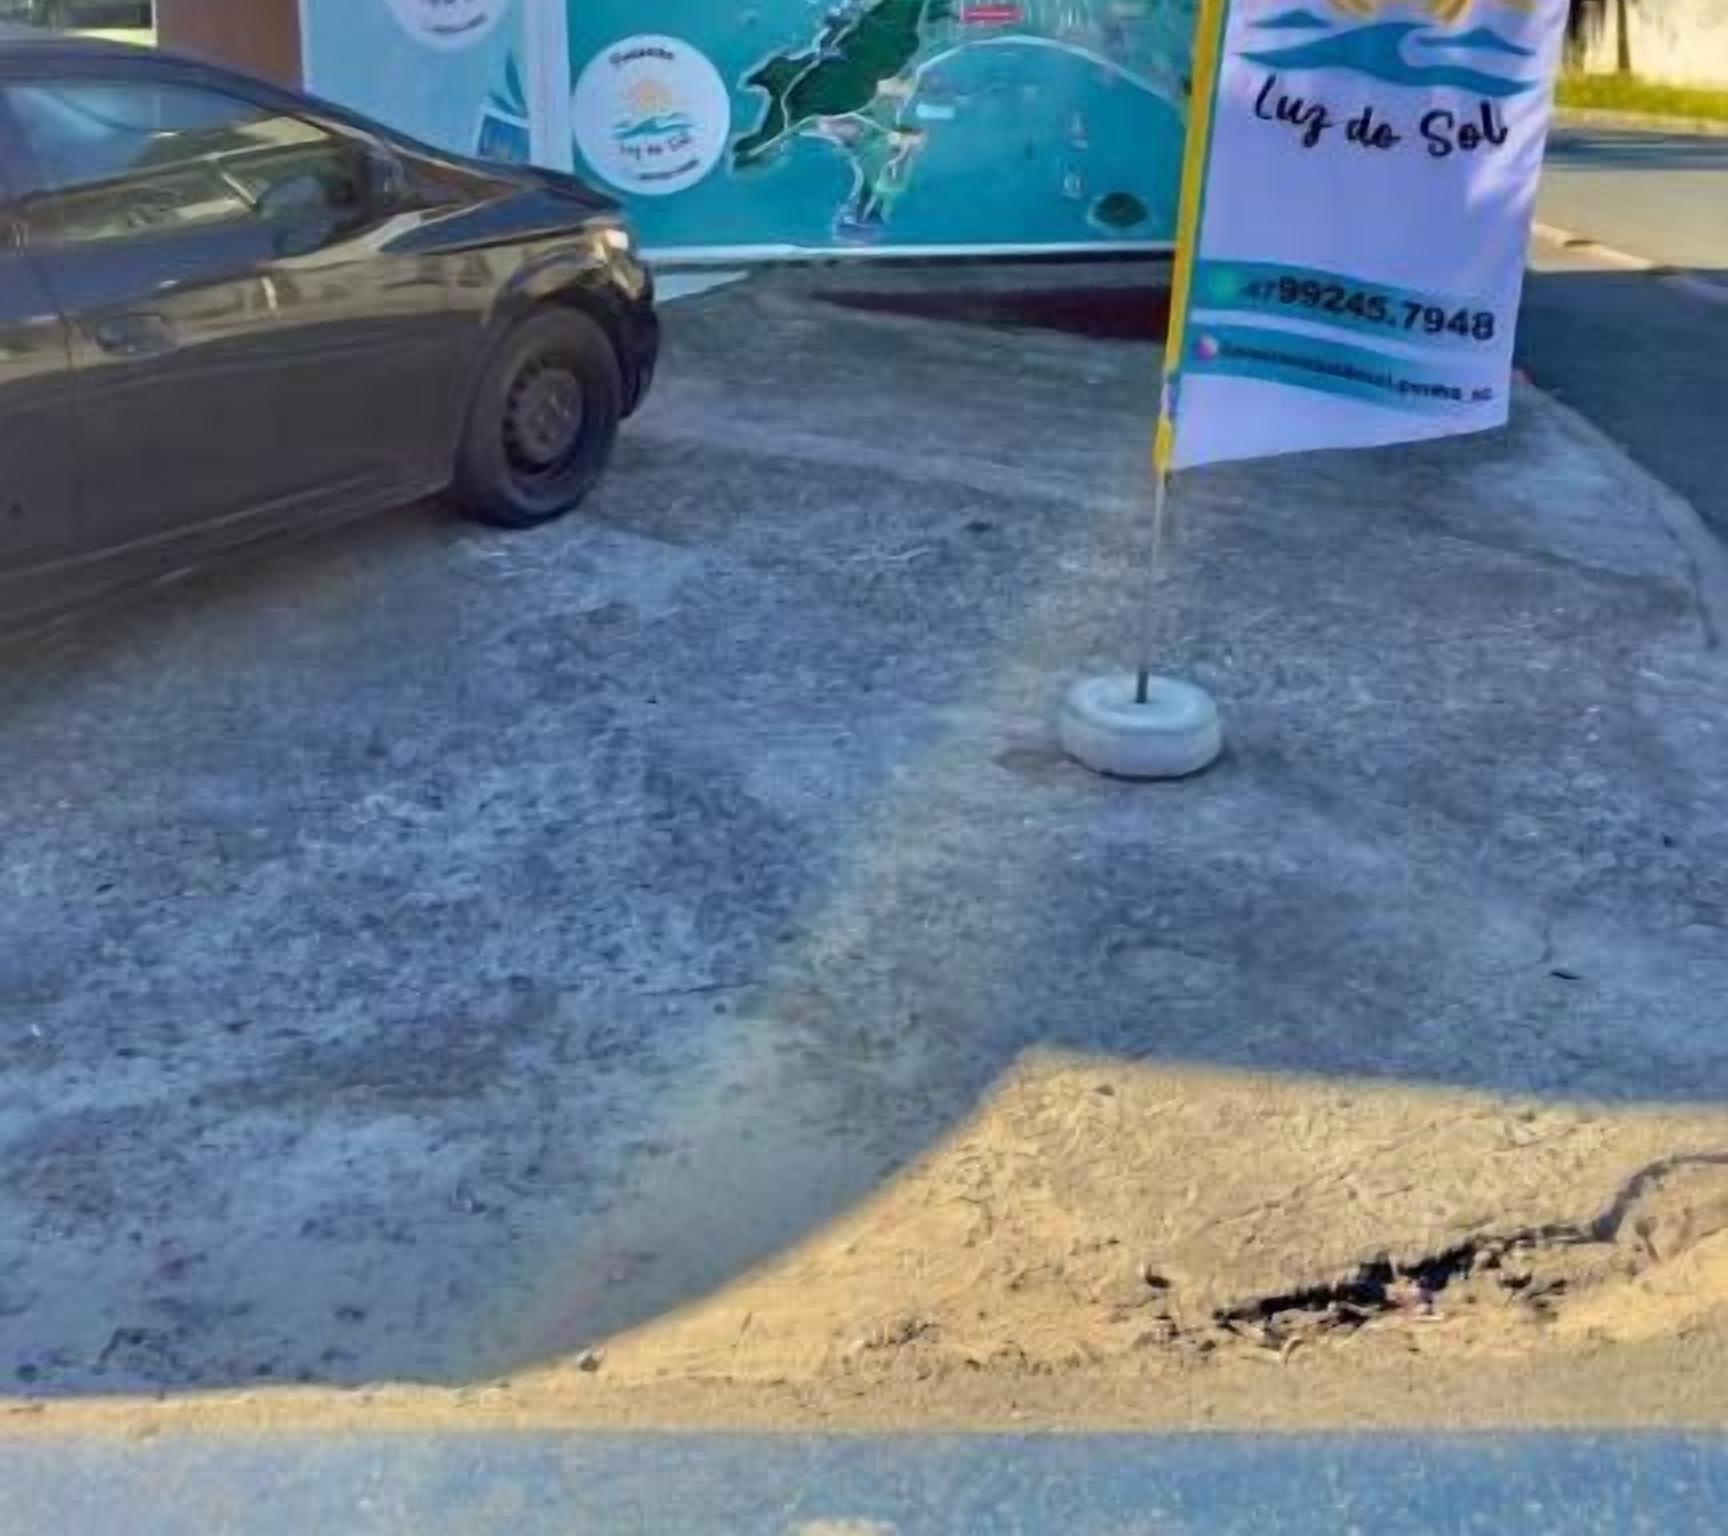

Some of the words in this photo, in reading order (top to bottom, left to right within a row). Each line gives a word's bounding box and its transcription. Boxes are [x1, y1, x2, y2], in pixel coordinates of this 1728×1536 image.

[1255, 73, 1335, 148] Luz
[1346, 106, 1400, 149] do
[1420, 100, 1508, 157] Sol
